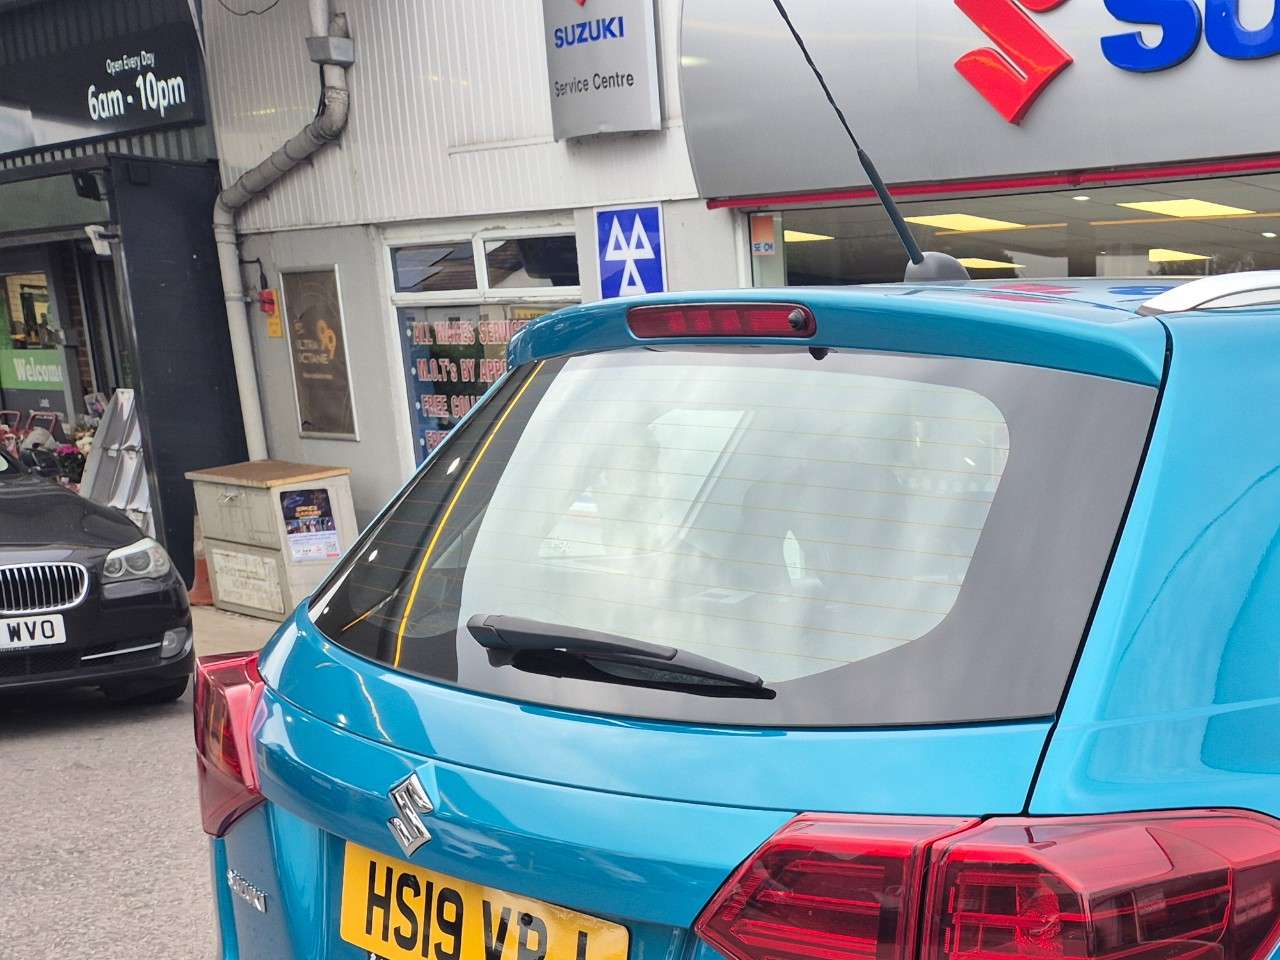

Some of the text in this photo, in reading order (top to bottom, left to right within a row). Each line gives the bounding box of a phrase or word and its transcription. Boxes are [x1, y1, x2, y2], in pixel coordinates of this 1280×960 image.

[554, 16, 624, 48] SUZUKI
[105, 50, 155, 76] Open Every Day
[87, 84, 125, 121] 6am
[135, 71, 186, 118] 10pm
[554, 72, 634, 98] Service Centre
[460, 358, 475, 382] BY
[421, 394, 449, 417] FREE
[7, 620, 55, 643] WVO
